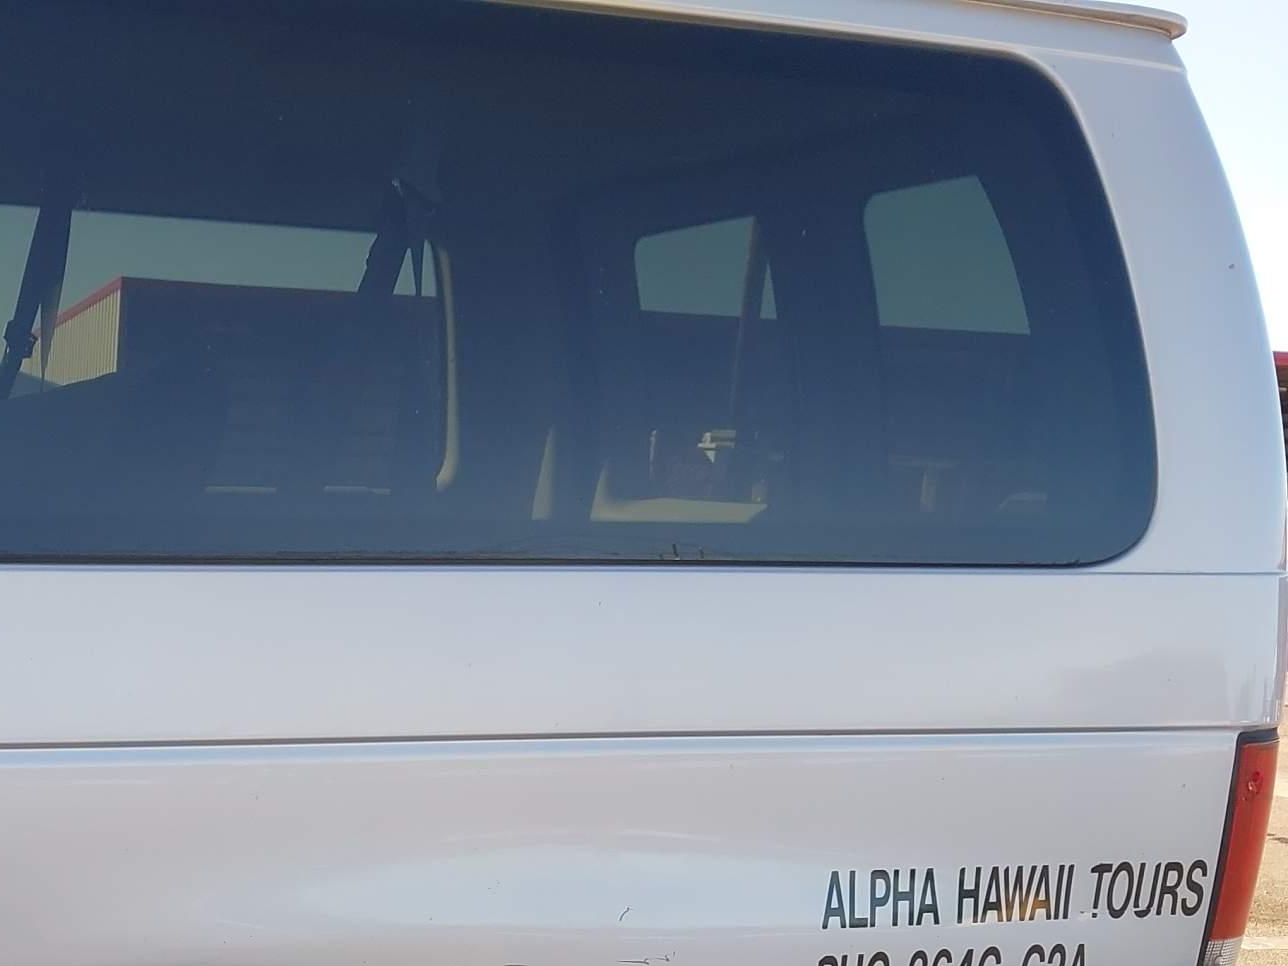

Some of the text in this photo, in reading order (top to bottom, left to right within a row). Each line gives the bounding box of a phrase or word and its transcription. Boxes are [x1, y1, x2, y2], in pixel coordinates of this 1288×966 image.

[821, 859, 1208, 930] ALPHA HAWAII TOURS
